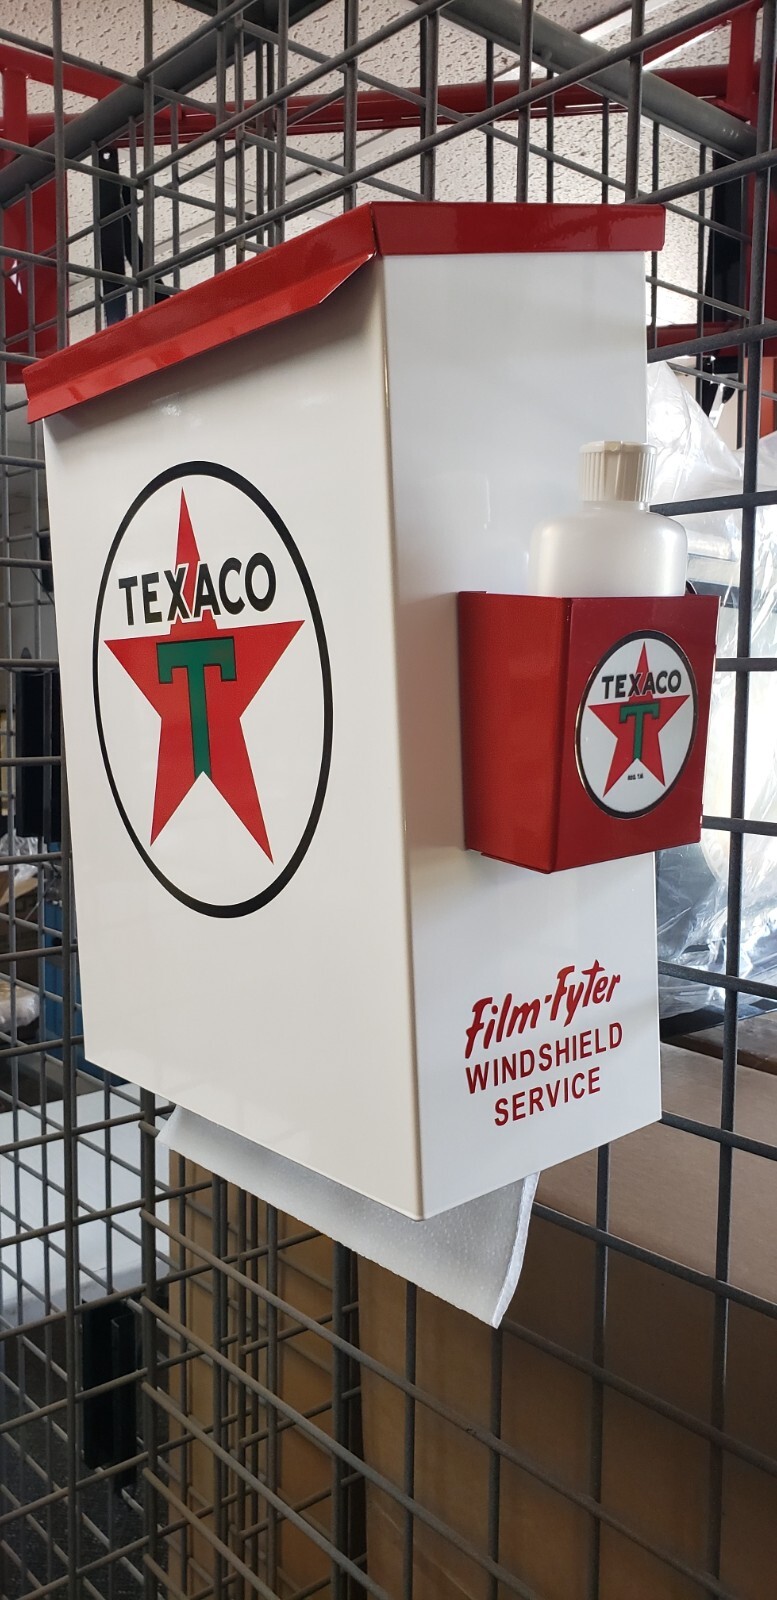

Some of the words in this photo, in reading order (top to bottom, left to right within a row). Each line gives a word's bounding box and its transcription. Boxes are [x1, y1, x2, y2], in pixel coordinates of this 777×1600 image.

[118, 552, 276, 625] TEXACO
[601, 669, 682, 699] TEXACO
[465, 1022, 623, 1095] WINDSHIELD
[494, 1066, 601, 1127] SERVICE
